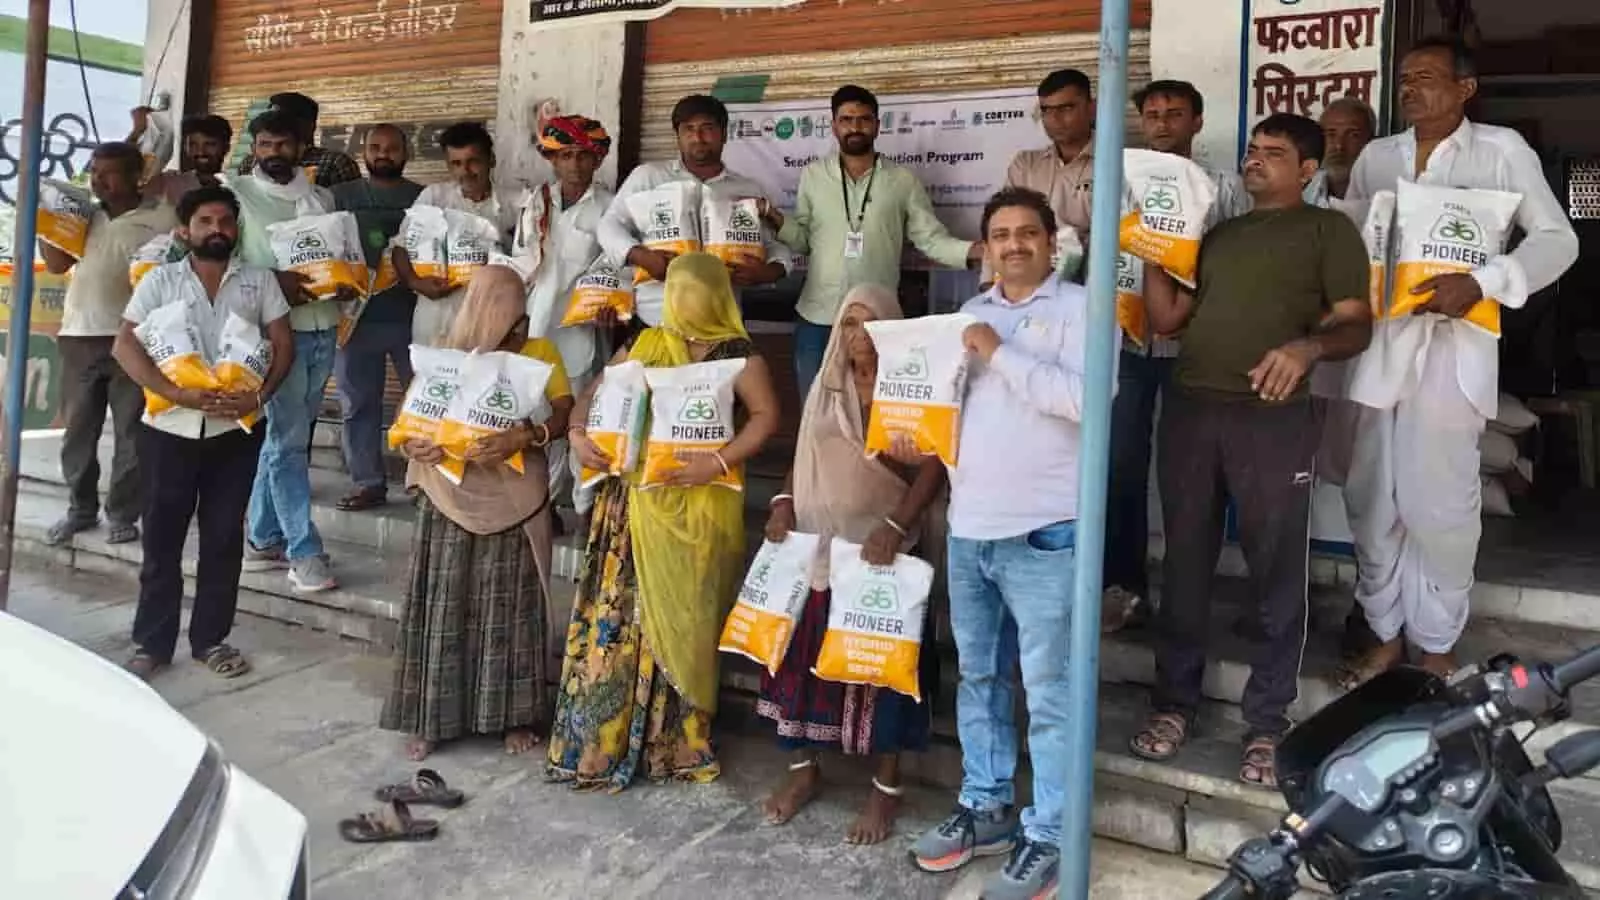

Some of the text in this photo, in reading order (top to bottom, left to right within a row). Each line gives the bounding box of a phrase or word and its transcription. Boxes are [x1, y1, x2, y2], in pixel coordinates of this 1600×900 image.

[1254, 7, 1379, 53] फव्वारा
[927, 152, 984, 166] Program
[1421, 243, 1488, 267] PIONEER
[879, 381, 933, 400] PIONEER
[671, 425, 725, 440] PIONEER
[843, 612, 904, 634] PIONEER
